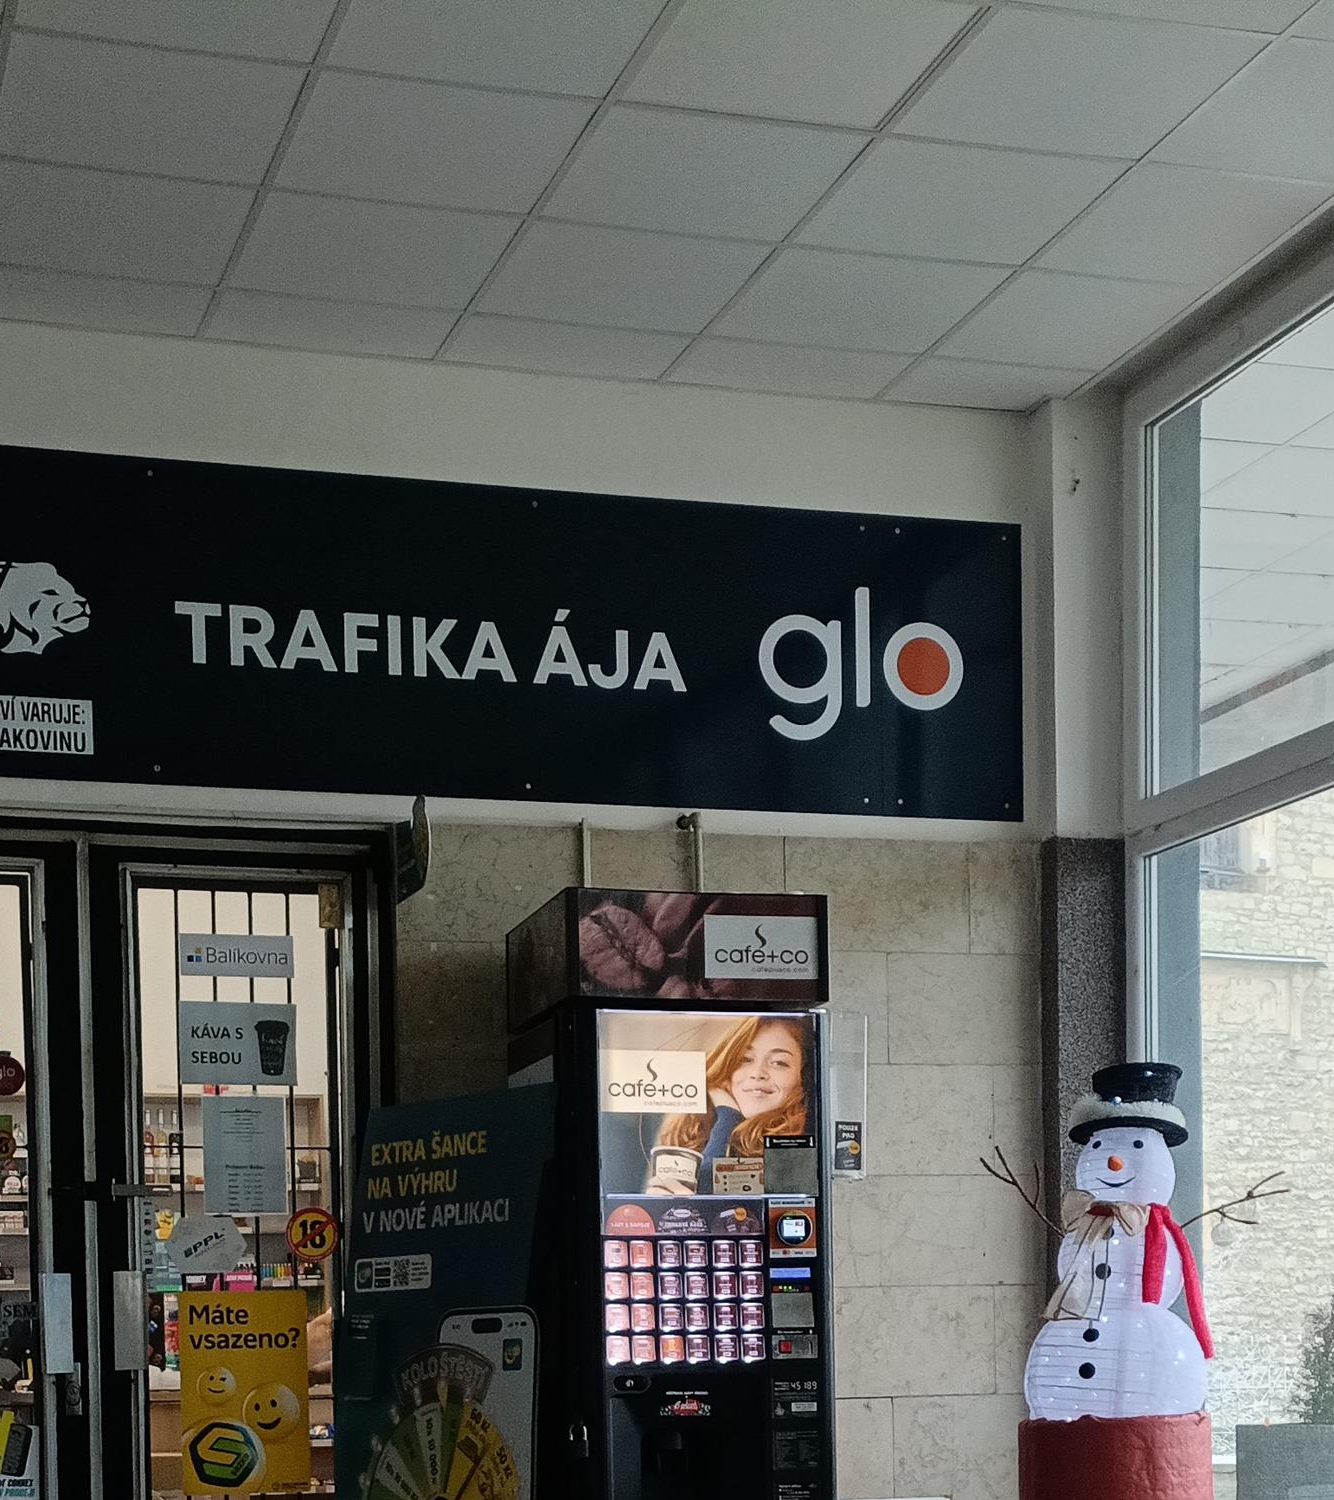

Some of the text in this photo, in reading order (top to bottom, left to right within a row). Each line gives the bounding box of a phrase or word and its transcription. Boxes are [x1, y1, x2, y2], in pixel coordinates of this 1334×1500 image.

[174, 601, 687, 692] TRAFIKA ÁJA
[758, 586, 964, 740] glo
[21, 701, 86, 725] VARUJE:
[205, 946, 289, 966] Balíkovna
[190, 1022, 244, 1040] KÁVA S
[190, 1049, 243, 1066] SEBOU
[370, 1129, 488, 1167] EXTRA ŠANCE
[367, 1167, 458, 1201] NA VÝHRU
[362, 1197, 510, 1234] V NOVÉ APLIKACI
[193, 1231, 225, 1254] PPL
[298, 1218, 329, 1251] 18
[188, 1303, 250, 1325] Máte
[188, 1328, 301, 1350] vsazeno?
